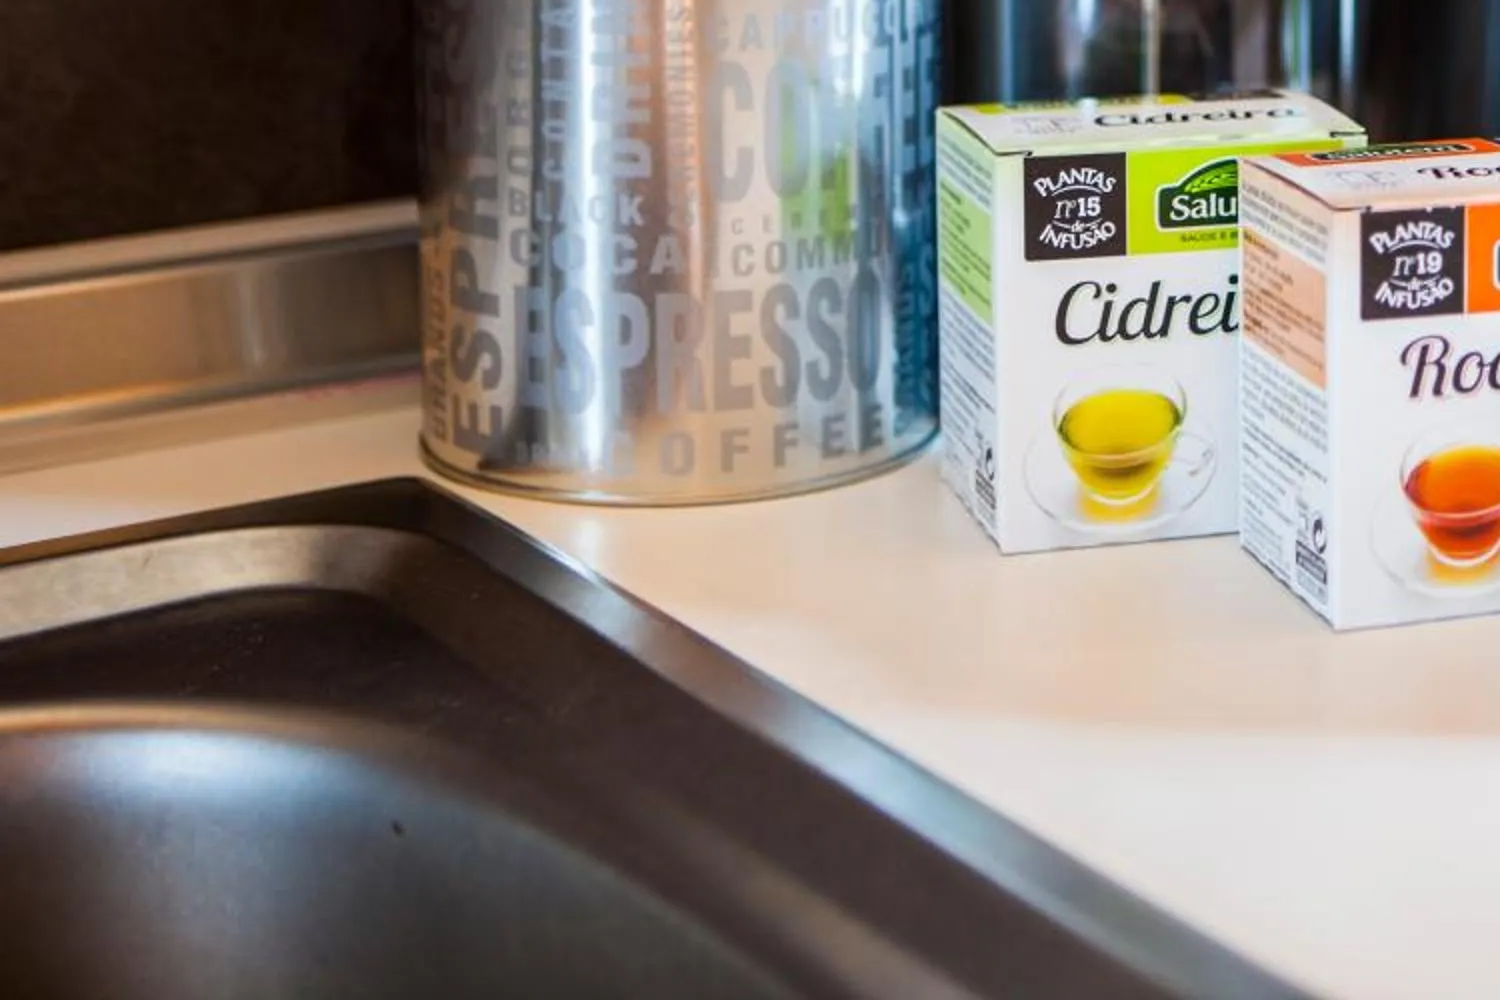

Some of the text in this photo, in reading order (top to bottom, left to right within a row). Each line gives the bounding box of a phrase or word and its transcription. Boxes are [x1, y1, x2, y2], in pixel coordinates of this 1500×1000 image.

[1094, 106, 1296, 128] Cidreira
[1033, 167, 1117, 197] PLANTAS
[1169, 192, 1238, 221] Salu
[1369, 220, 1456, 254] PLANTAS
[1055, 273, 1238, 346] Cidrei
[513, 260, 882, 417] ESPRESSO
[610, 402, 885, 477] COFFEE
